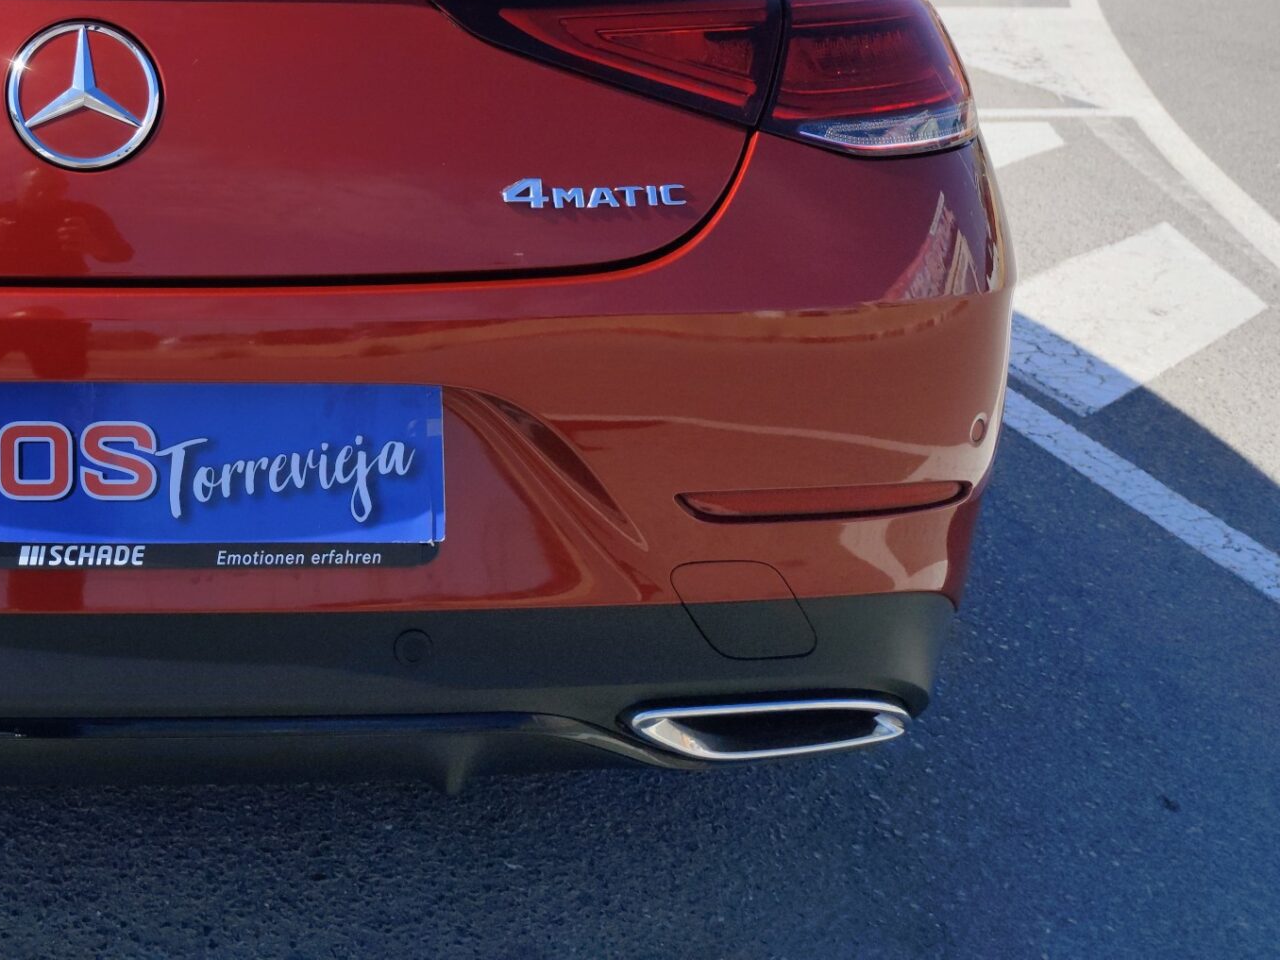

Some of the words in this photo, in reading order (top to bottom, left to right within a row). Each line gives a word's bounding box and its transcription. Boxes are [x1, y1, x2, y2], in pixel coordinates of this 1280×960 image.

[501, 177, 687, 209] 4MATIC
[155, 435, 416, 523] Torrevieja
[48, 545, 146, 566] SCHADE
[216, 549, 305, 566] Emotionen
[311, 549, 382, 566] erfahren
